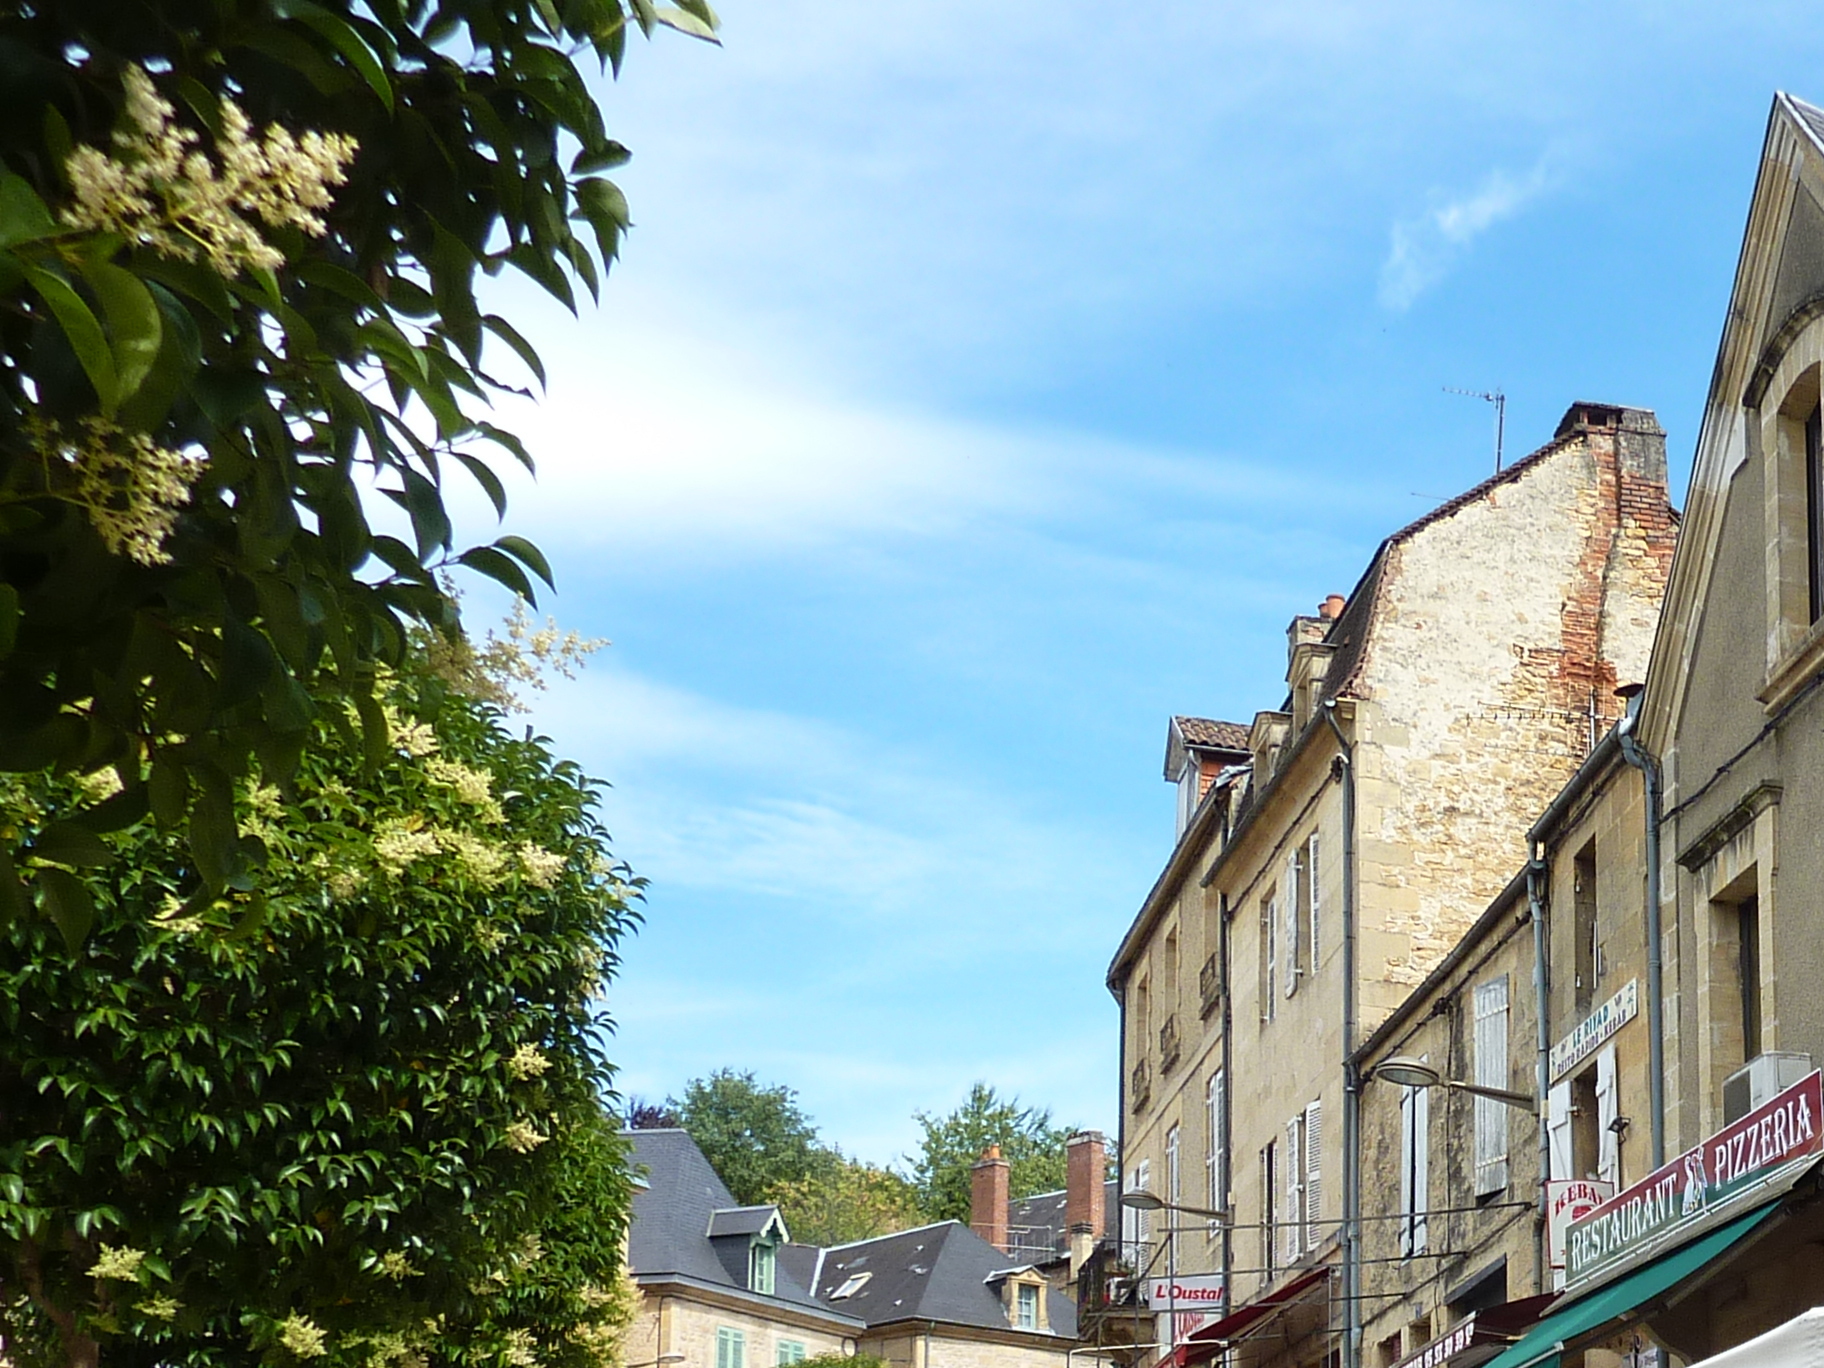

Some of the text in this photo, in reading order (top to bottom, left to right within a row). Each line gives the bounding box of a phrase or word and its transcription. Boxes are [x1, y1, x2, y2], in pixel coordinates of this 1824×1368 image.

[1573, 1005, 1609, 1048] LE RIYAD
[1604, 1009, 1626, 1037] KEBAB
[1571, 1093, 1815, 1271] RESTAURANT PIZZERIA
[1156, 1284, 1223, 1301] L'Oustal
